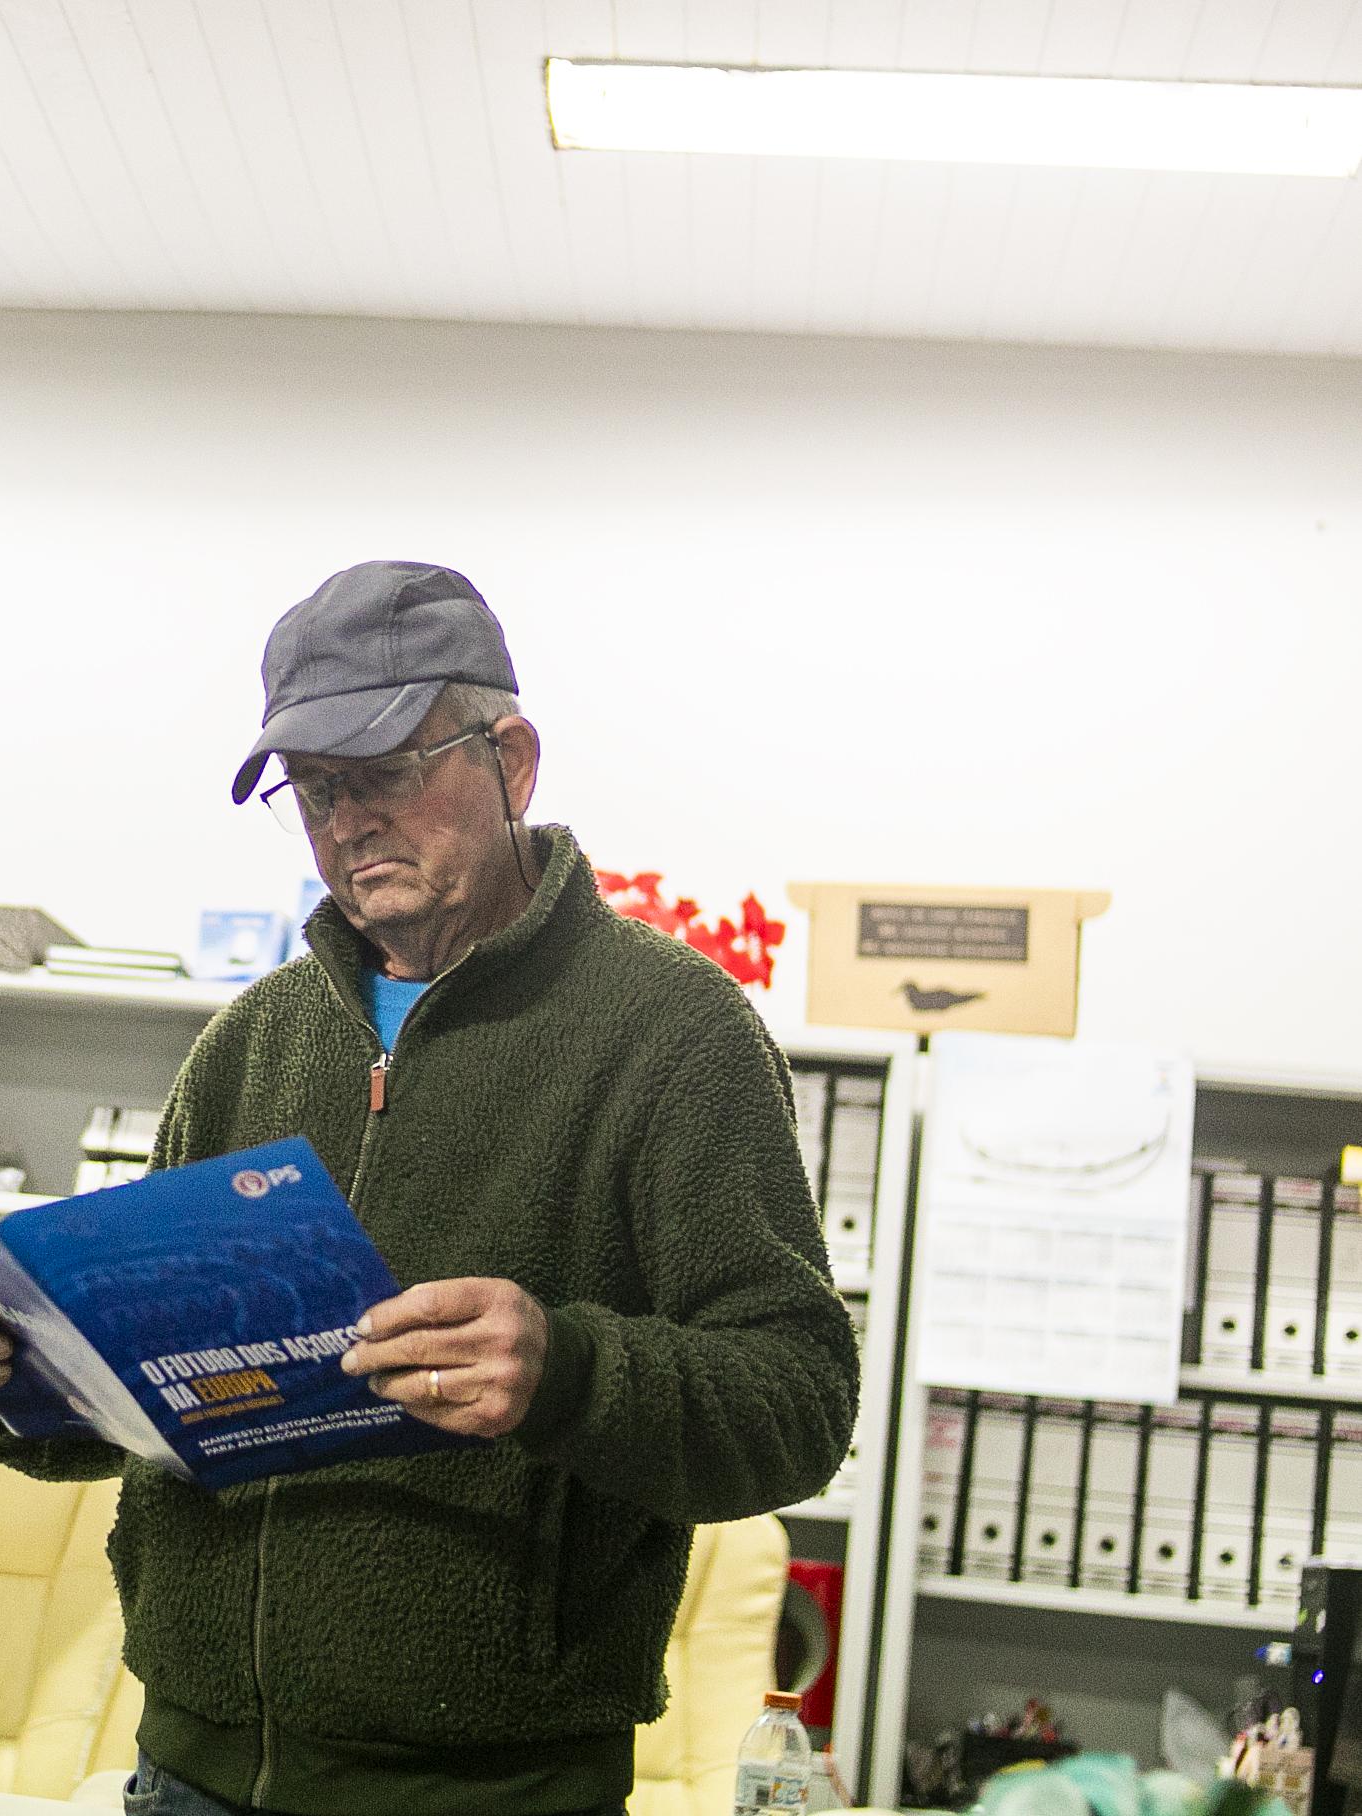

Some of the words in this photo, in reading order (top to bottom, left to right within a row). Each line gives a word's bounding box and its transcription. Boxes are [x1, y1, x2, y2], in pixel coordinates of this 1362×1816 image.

[267, 1164, 302, 1187] PS
[140, 1360, 166, 1386] O
[157, 1347, 245, 1382] FUTURO
[235, 1341, 290, 1367] DOS
[160, 1382, 202, 1412] NA
[191, 1369, 278, 1403] EUROPA
[198, 1427, 263, 1448] MANIFESTO
[263, 1414, 325, 1433] ELEITORAL
[325, 1411, 344, 1422] DO
[344, 1403, 404, 1419] PS/AÇORE
[205, 1442, 237, 1457] PARA
